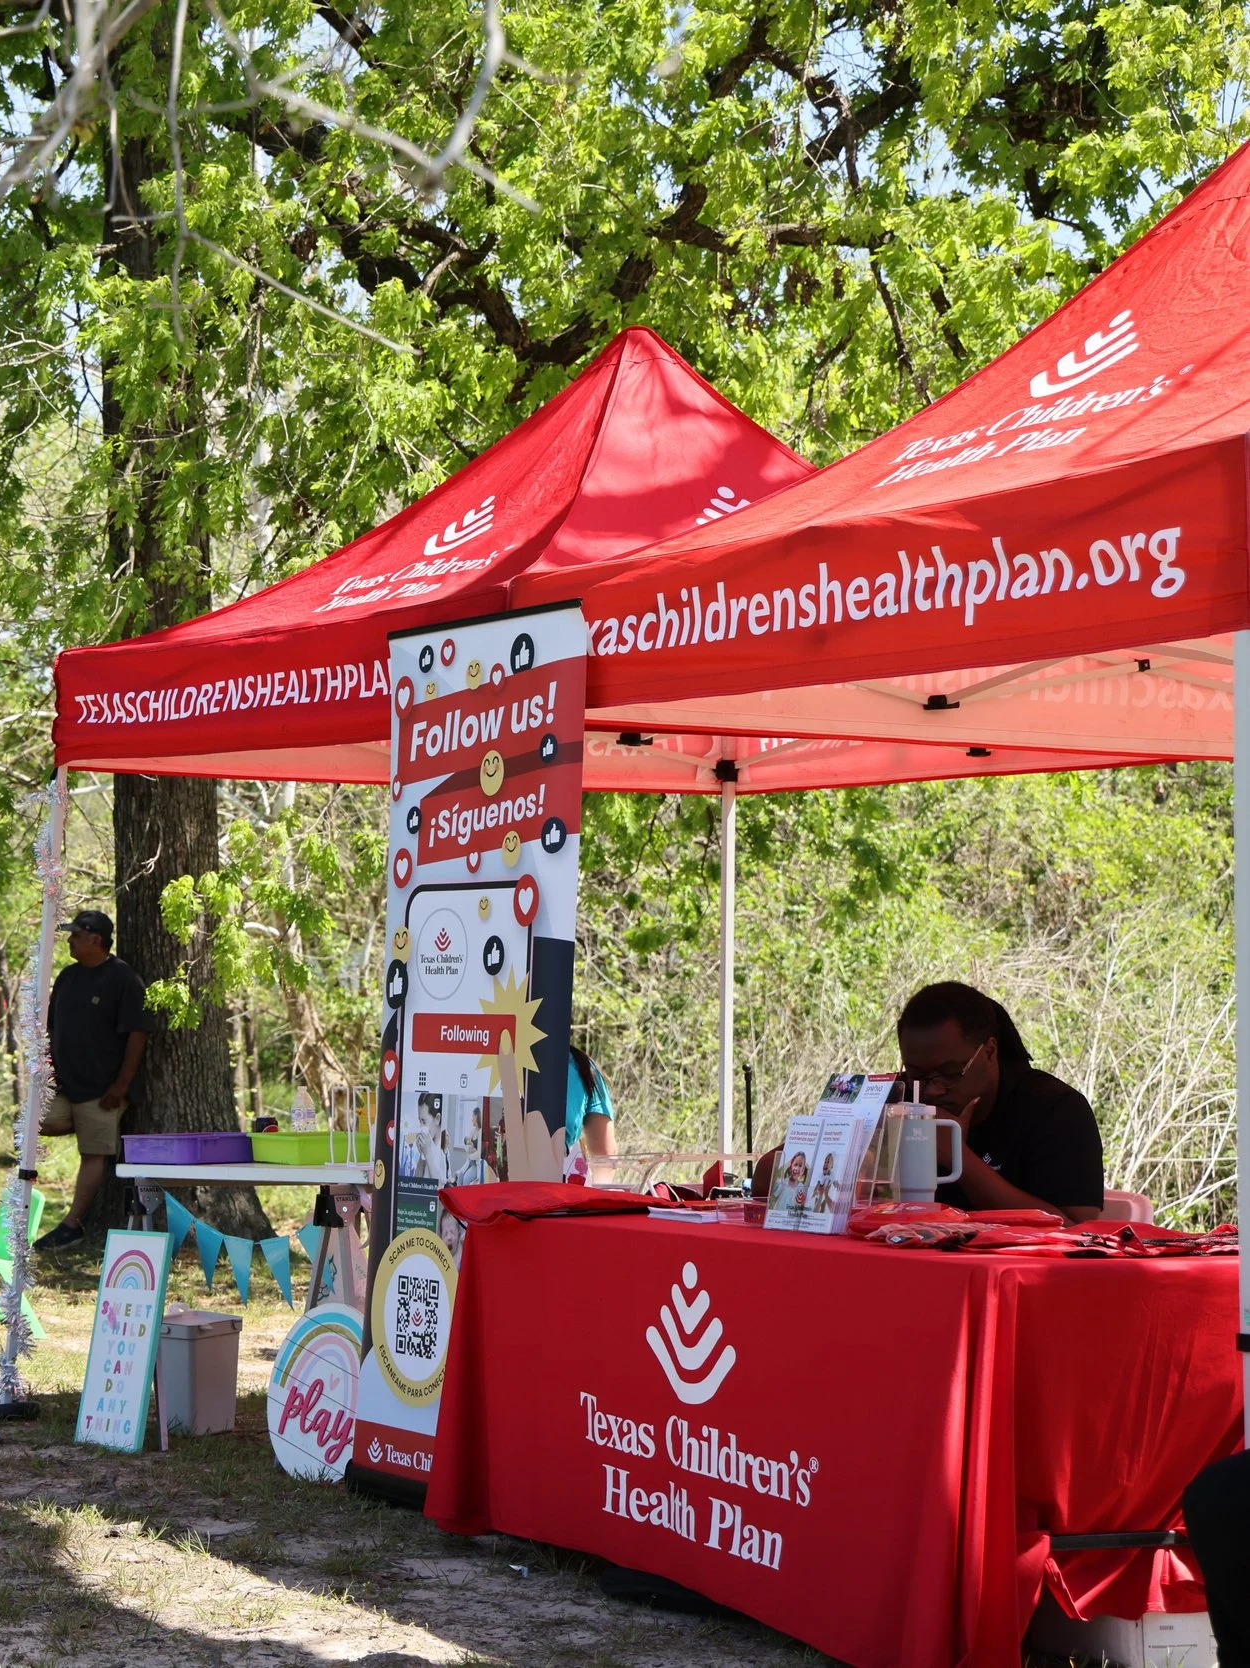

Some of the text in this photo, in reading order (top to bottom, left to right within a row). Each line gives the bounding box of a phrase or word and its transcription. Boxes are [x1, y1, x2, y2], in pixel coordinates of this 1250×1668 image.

[872, 426, 1087, 489] Health Plan
[888, 425, 987, 465] Texas
[330, 572, 393, 596] Texas
[311, 581, 443, 613] Health Plan
[74, 658, 392, 725] TEXASCHILDRENSHEALTHPLA
[409, 680, 558, 762] Follow us!
[428, 783, 546, 848] ¡Síguenos!
[420, 954, 436, 964] Texas
[425, 965, 459, 975] Health Plan
[440, 1024, 490, 1047] Following
[389, 1237, 451, 1272] SCAN ME TO CONNECT
[101, 1300, 152, 1319] SWEET
[101, 1320, 147, 1338] CHILD
[107, 1340, 136, 1357] YOU
[103, 1360, 133, 1377] CAN
[379, 1344, 407, 1394] ESCANEAME
[406, 1385, 423, 1398] PARA
[105, 1378, 125, 1394] DO
[96, 1397, 127, 1415] ANY
[85, 1415, 131, 1435] THING
[277, 1378, 354, 1465] play
[580, 1391, 656, 1459] Texas
[385, 1443, 412, 1468] Texas
[602, 1463, 783, 1571] Health Plan
